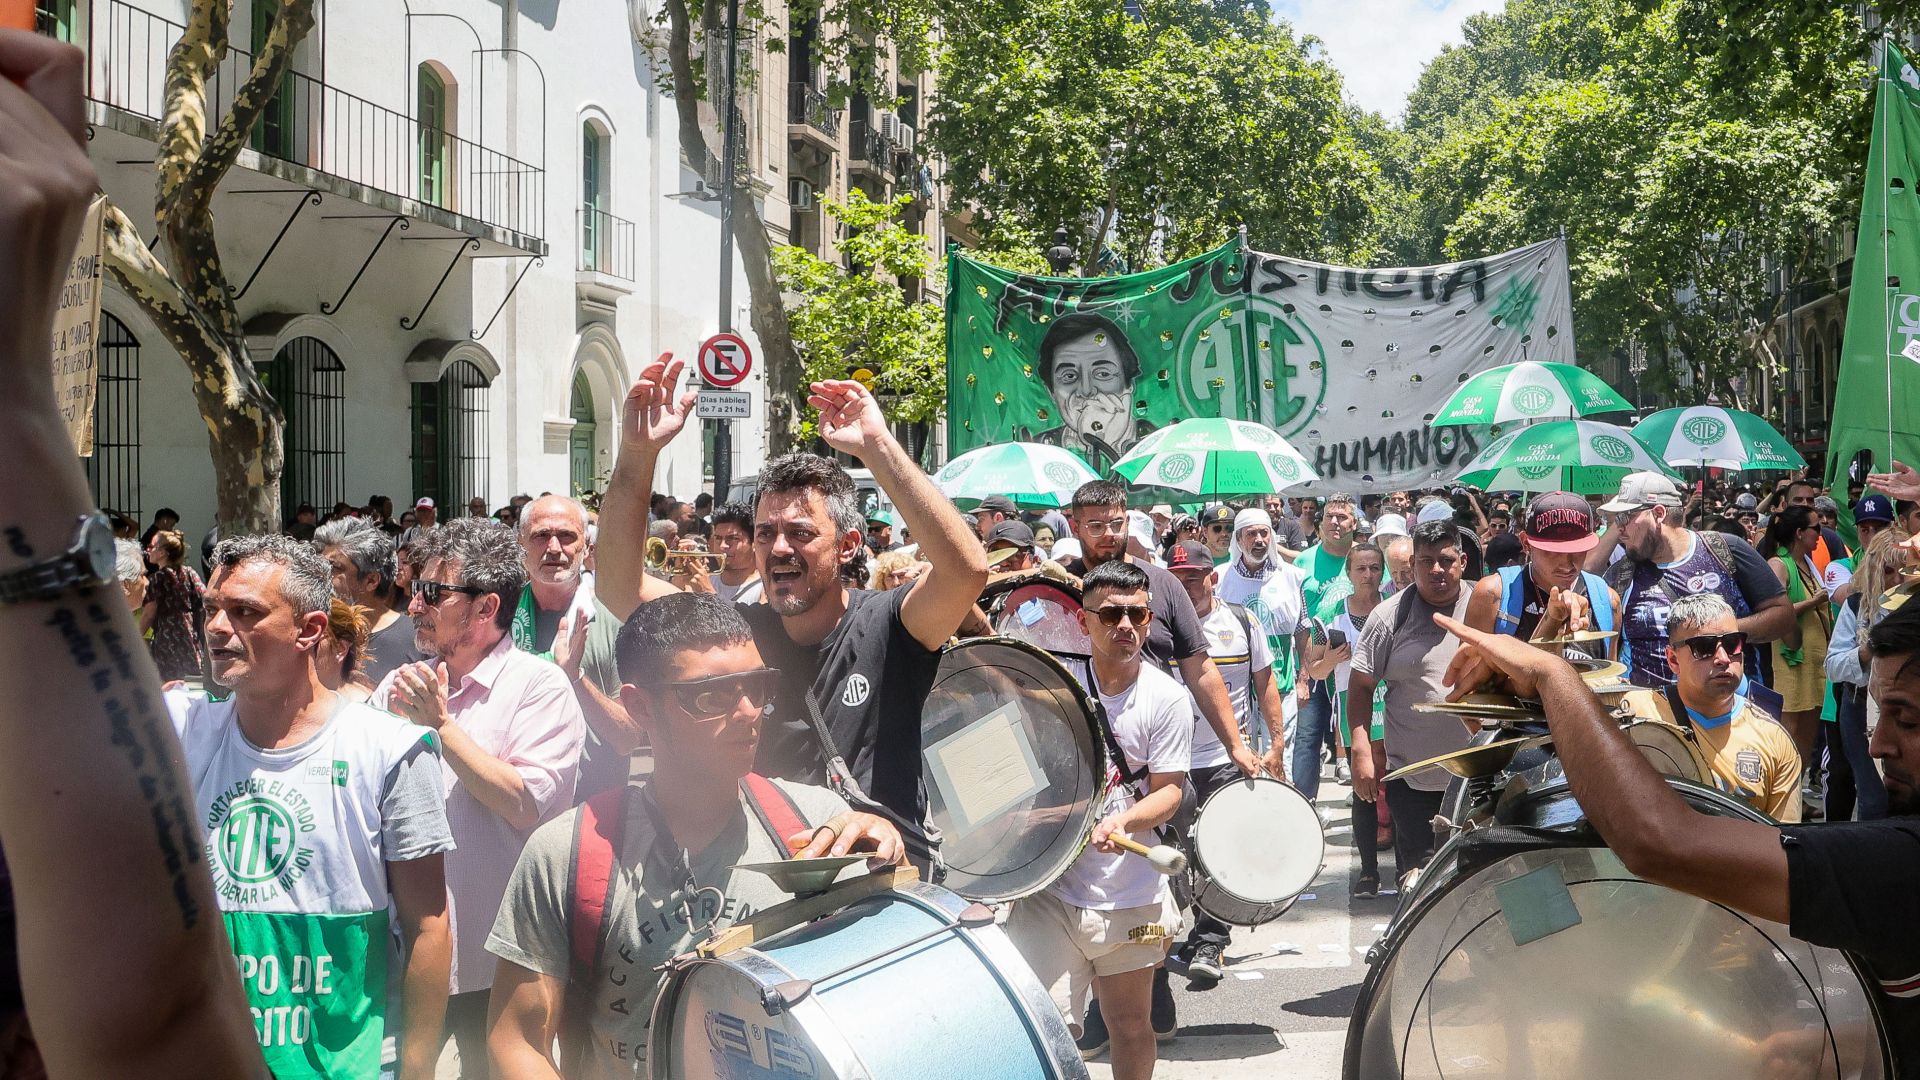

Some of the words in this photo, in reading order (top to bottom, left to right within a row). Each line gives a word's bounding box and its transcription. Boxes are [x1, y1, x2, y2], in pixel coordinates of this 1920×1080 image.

[994, 275, 1120, 334] ATE
[1169, 256, 1486, 304] JUSTICIA
[714, 345, 736, 375] E
[1189, 304, 1307, 429] ATE
[1581, 388, 1598, 396] CASA
[1584, 399, 1615, 409] MONEDA
[1450, 408, 1484, 418] MONEDA
[1691, 421, 1716, 438] ATE
[1315, 424, 1479, 478] HUMANOS
[1601, 440, 1624, 457] ATE
[1754, 440, 1773, 449] CASA
[1762, 447, 1773, 455] DE
[1514, 454, 1561, 462] MONEDA
[1754, 453, 1787, 462] MONEDA
[1173, 545, 1187, 562] LA
[307, 766, 331, 777] VERDE
[268, 780, 285, 797] EL
[283, 788, 317, 833] ESTADO
[227, 805, 285, 876] ATE
[213, 874, 258, 905] LIBERAR
[261, 884, 279, 902] LA
[278, 847, 315, 893] NACION
[232, 954, 279, 996] PO
[291, 955, 333, 995] DE
